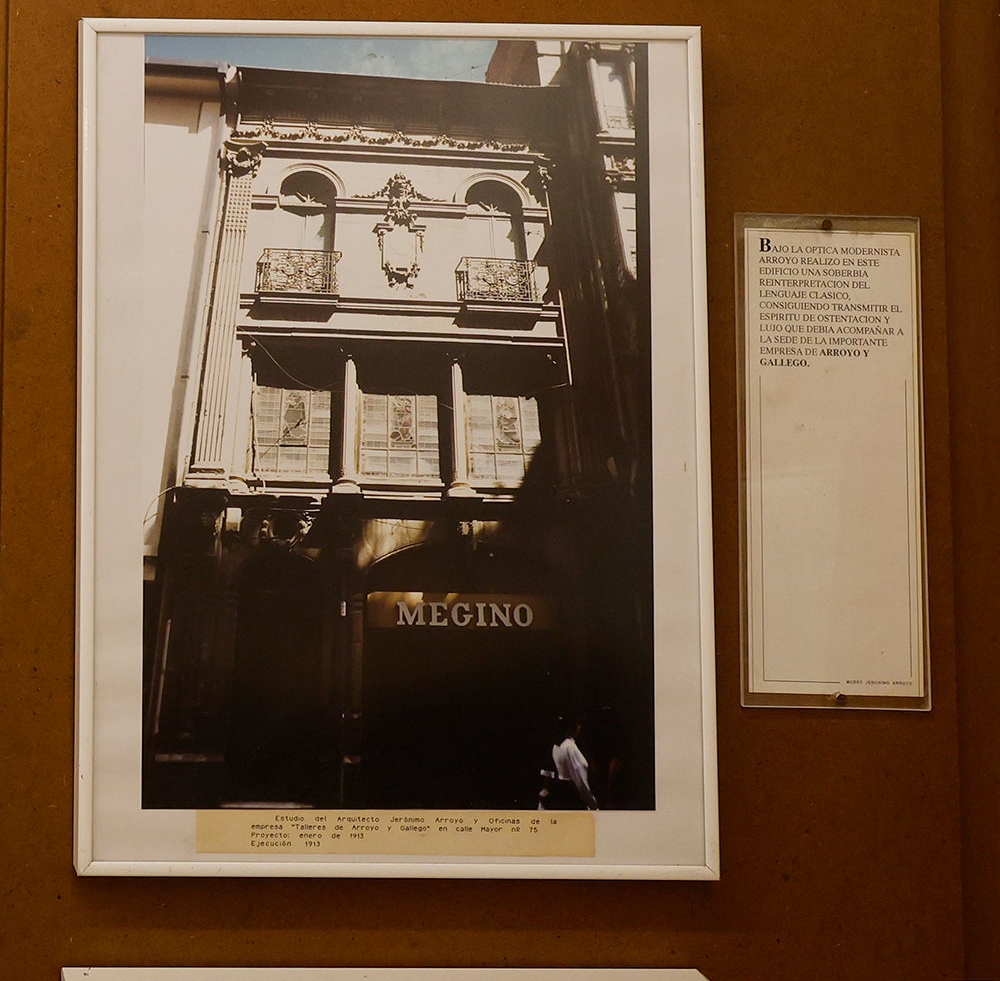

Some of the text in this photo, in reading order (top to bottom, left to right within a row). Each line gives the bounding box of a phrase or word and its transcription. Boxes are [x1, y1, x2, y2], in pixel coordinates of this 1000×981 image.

[759, 237, 900, 256] BAJO LA OPTICA MODERNISTA
[758, 255, 879, 267] ARROYO REALIZO EN ESTE
[759, 266, 868, 277] EDIFICIO UNA SOBERBIA
[759, 277, 870, 289] REINTERPRETACION DEL
[759, 289, 851, 300] LENGUAJE CLASICO,
[759, 300, 902, 313] CONSIGUIENDO TRANSMITIR EL
[759, 312, 890, 324] ESPIRITU DE OSTENTACION Y
[759, 323, 904, 336] LUJO QUE DEBIA ACOMPAÑAR A
[759, 334, 888, 346] LA SEDE DE LA IMPORTANTE
[760, 346, 869, 357] EMPRESA DE ARROYO Y
[759, 357, 809, 367] GALLEGO.
[396, 601, 533, 627] MEGINO
[275, 814, 304, 822] Estudio
[336, 815, 379, 823] Arquitecto
[434, 816, 463, 824] Arroyo
